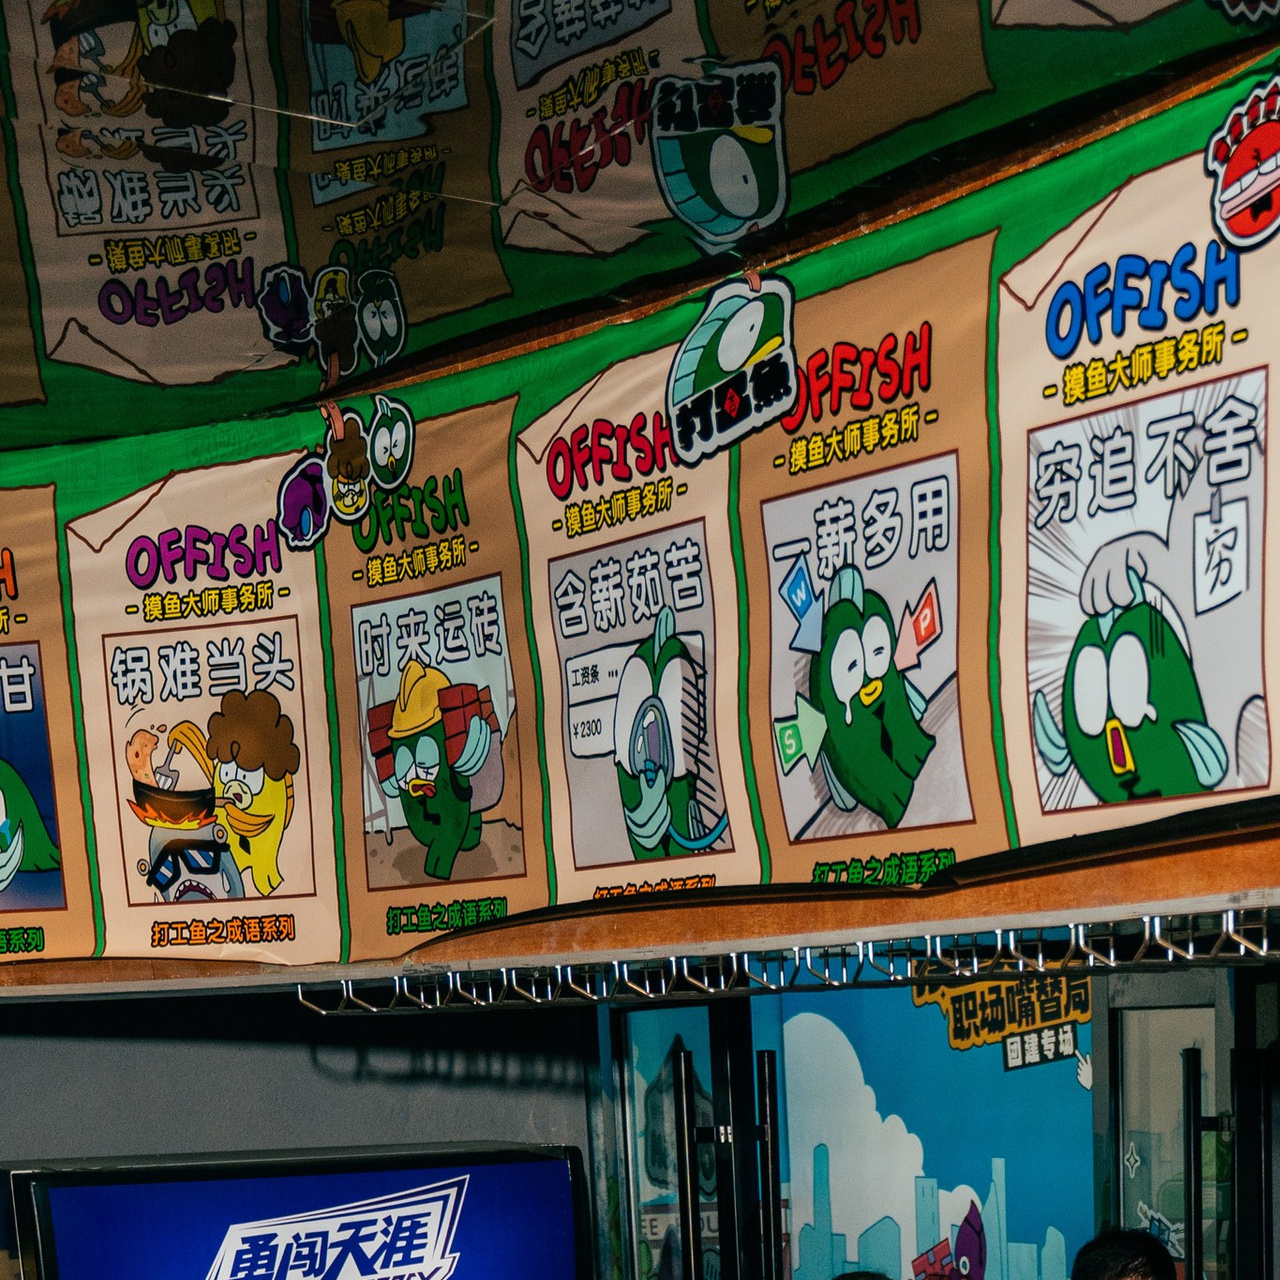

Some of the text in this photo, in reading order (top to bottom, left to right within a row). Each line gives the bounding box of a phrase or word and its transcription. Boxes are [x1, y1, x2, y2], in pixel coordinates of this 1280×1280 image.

[1045, 241, 1242, 360] OFFISH
[1064, 329, 1225, 406] 摸鱼大师事务所
[788, 414, 920, 475] 摸鱼大师事务所
[1034, 396, 1260, 531] 穷追不舍
[564, 484, 674, 538] 摸鱼大师事务所
[772, 472, 952, 579] 一薪多用
[126, 519, 283, 589] OFFISH
[367, 541, 467, 589] 摸鱼大师事务所
[143, 581, 274, 623] 摸鱼大师事务所
[552, 537, 705, 640] 含薪茹苦
[357, 590, 504, 678] 时来运砖
[917, 608, 933, 638] P
[110, 631, 297, 706] 锅难当头
[571, 664, 600, 687] 工资条
[782, 729, 797, 755] S
[151, 914, 296, 948] 打工鱼之成语系列
[386, 896, 508, 937] 打工鱼之成语系列
